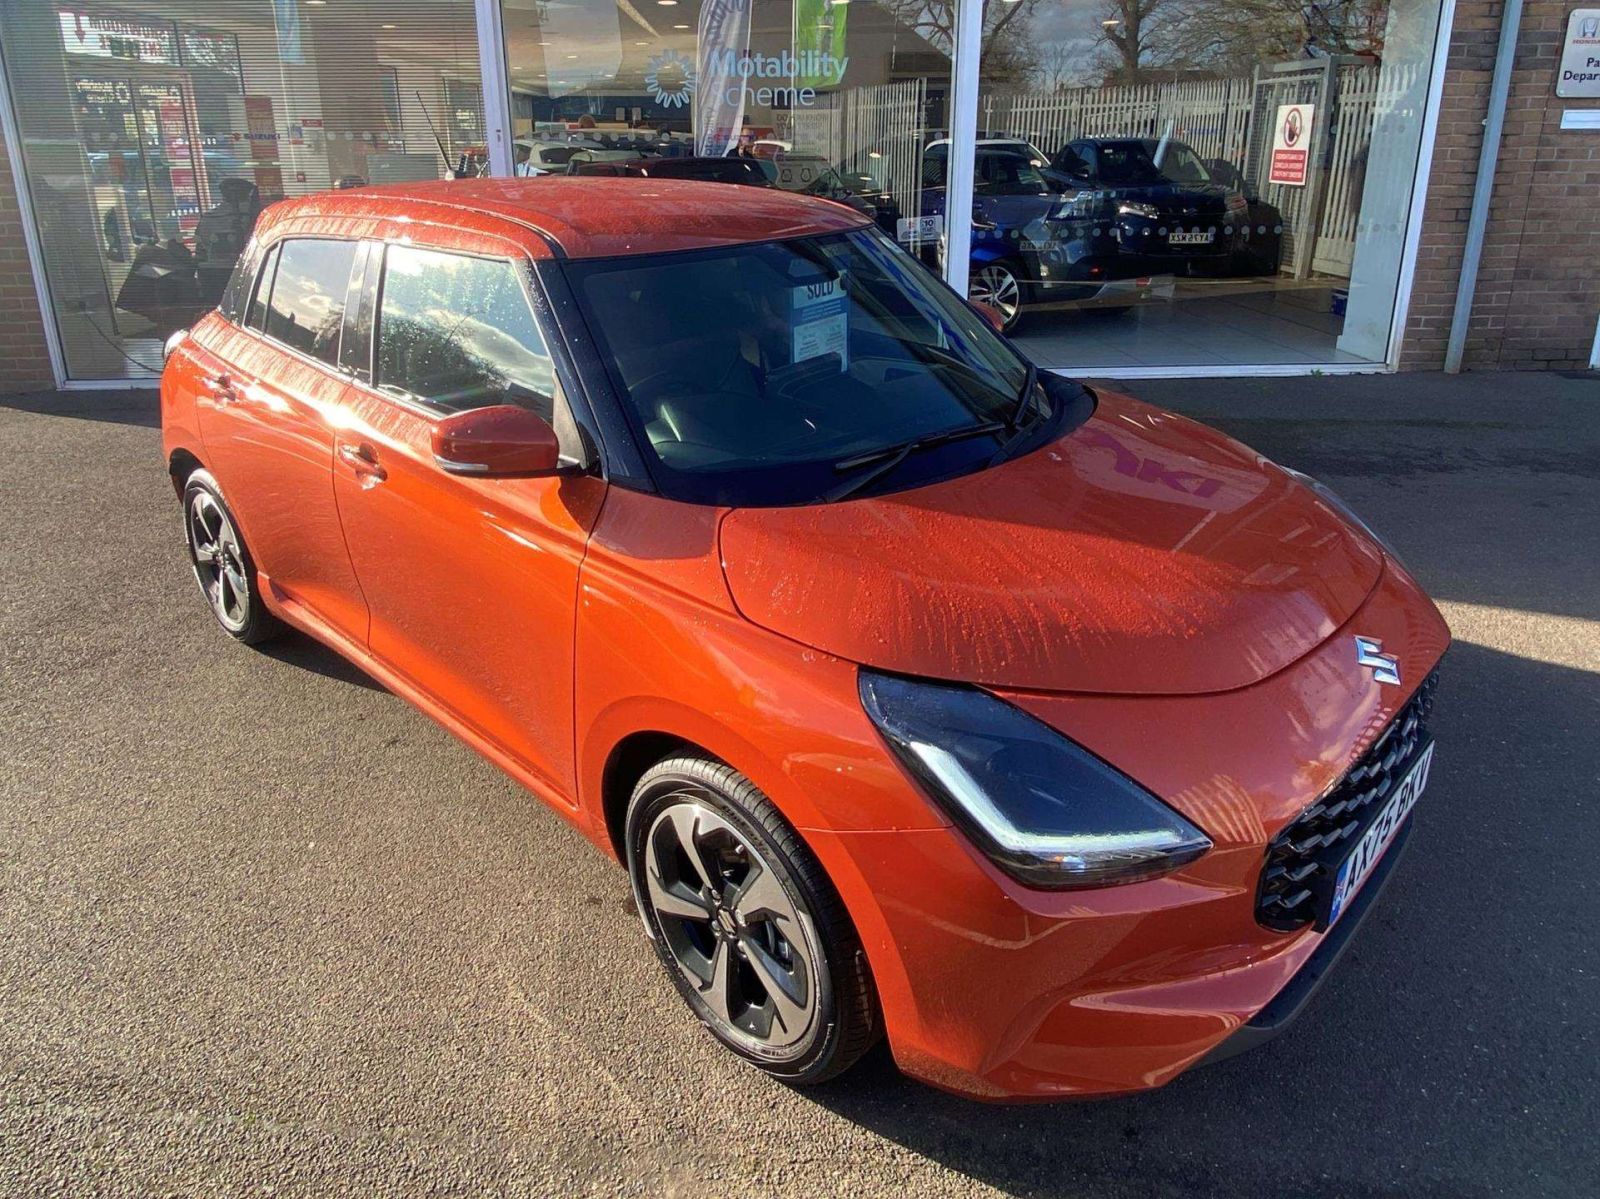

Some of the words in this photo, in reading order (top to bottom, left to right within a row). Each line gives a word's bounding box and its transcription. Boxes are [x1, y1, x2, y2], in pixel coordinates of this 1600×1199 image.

[710, 49, 849, 84] Motability
[1563, 70, 1600, 83] Depar
[807, 280, 834, 300] SOLD
[1344, 802, 1396, 899] AX75
